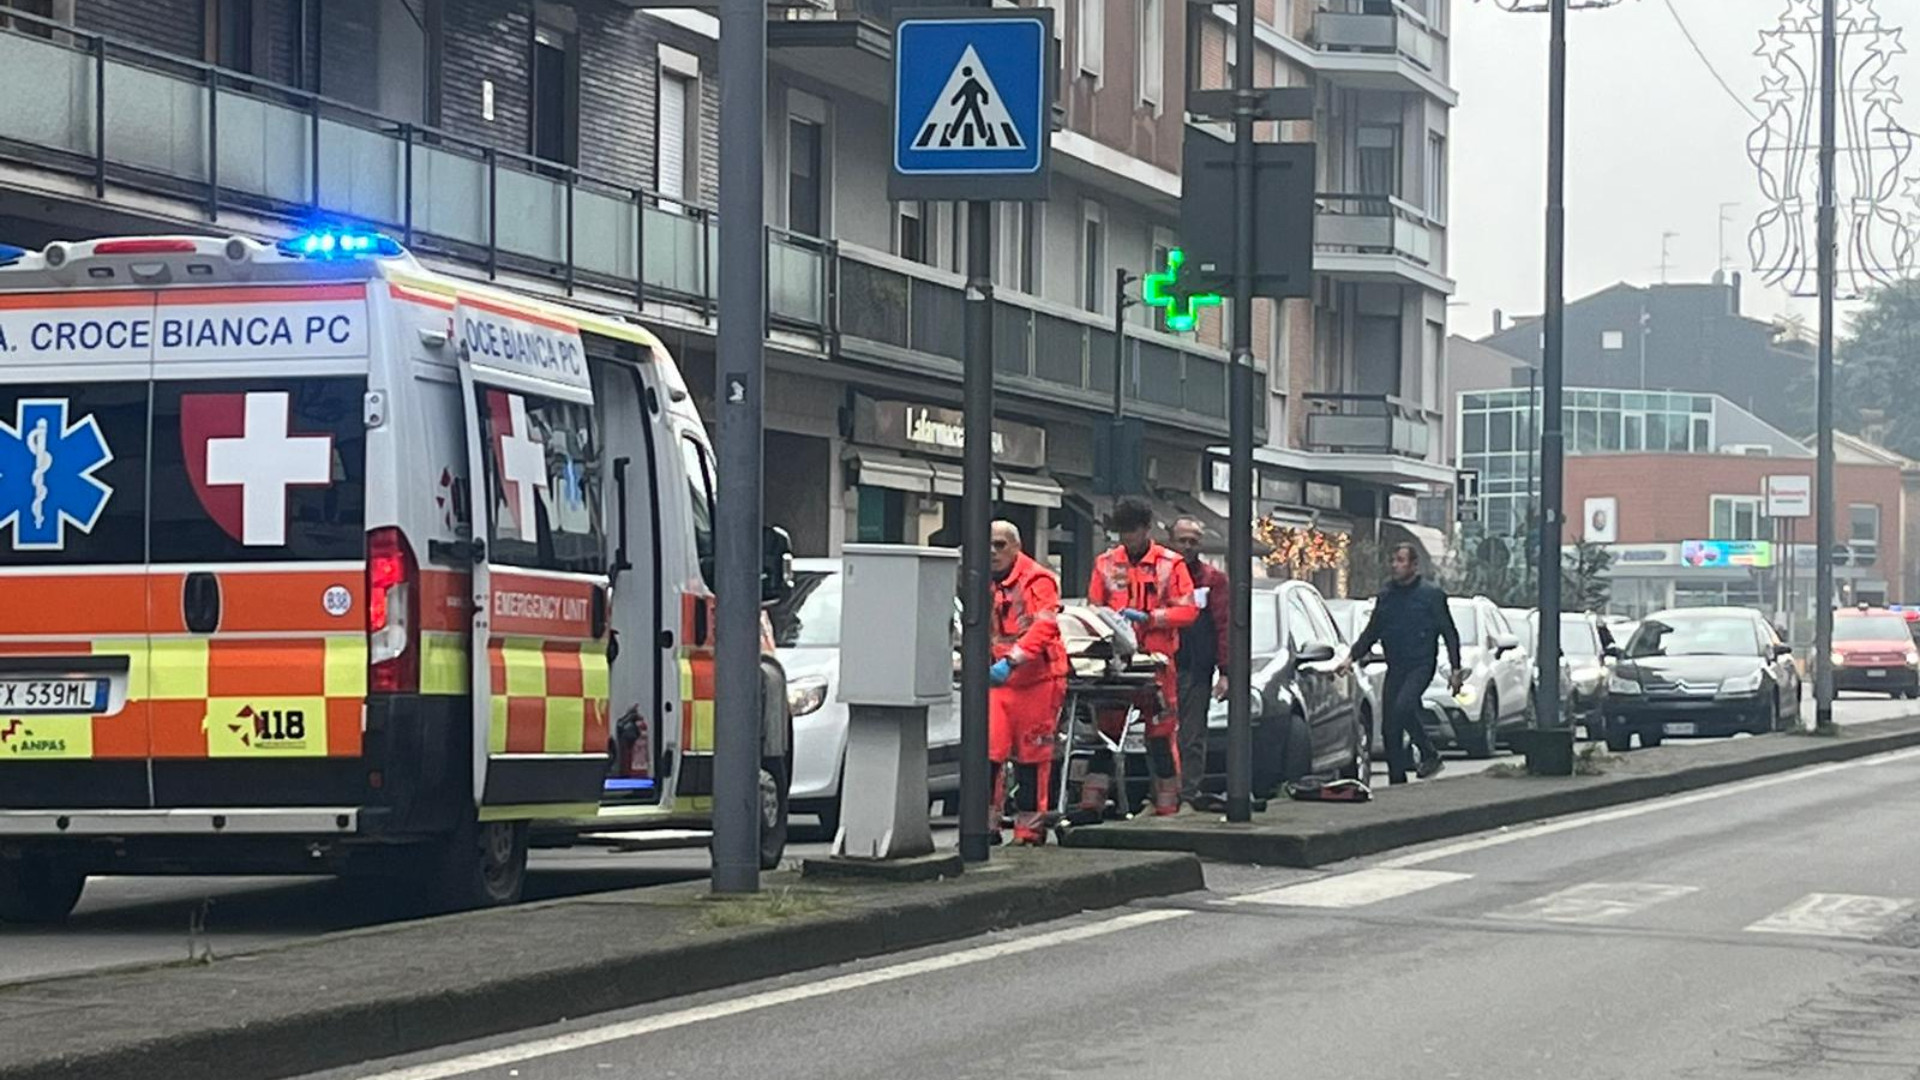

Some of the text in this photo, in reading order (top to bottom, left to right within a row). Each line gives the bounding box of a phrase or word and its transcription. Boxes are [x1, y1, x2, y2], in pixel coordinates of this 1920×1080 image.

[30, 319, 150, 351] CROCE
[162, 316, 292, 347] BIANCA
[305, 315, 350, 345] PC
[500, 326, 559, 372] BIANCA
[558, 341, 580, 375] PC
[494, 591, 588, 621] EMERGENCY UNIT
[0, 683, 17, 705] X
[260, 710, 305, 739] 118
[21, 740, 66, 751] ANPAS
